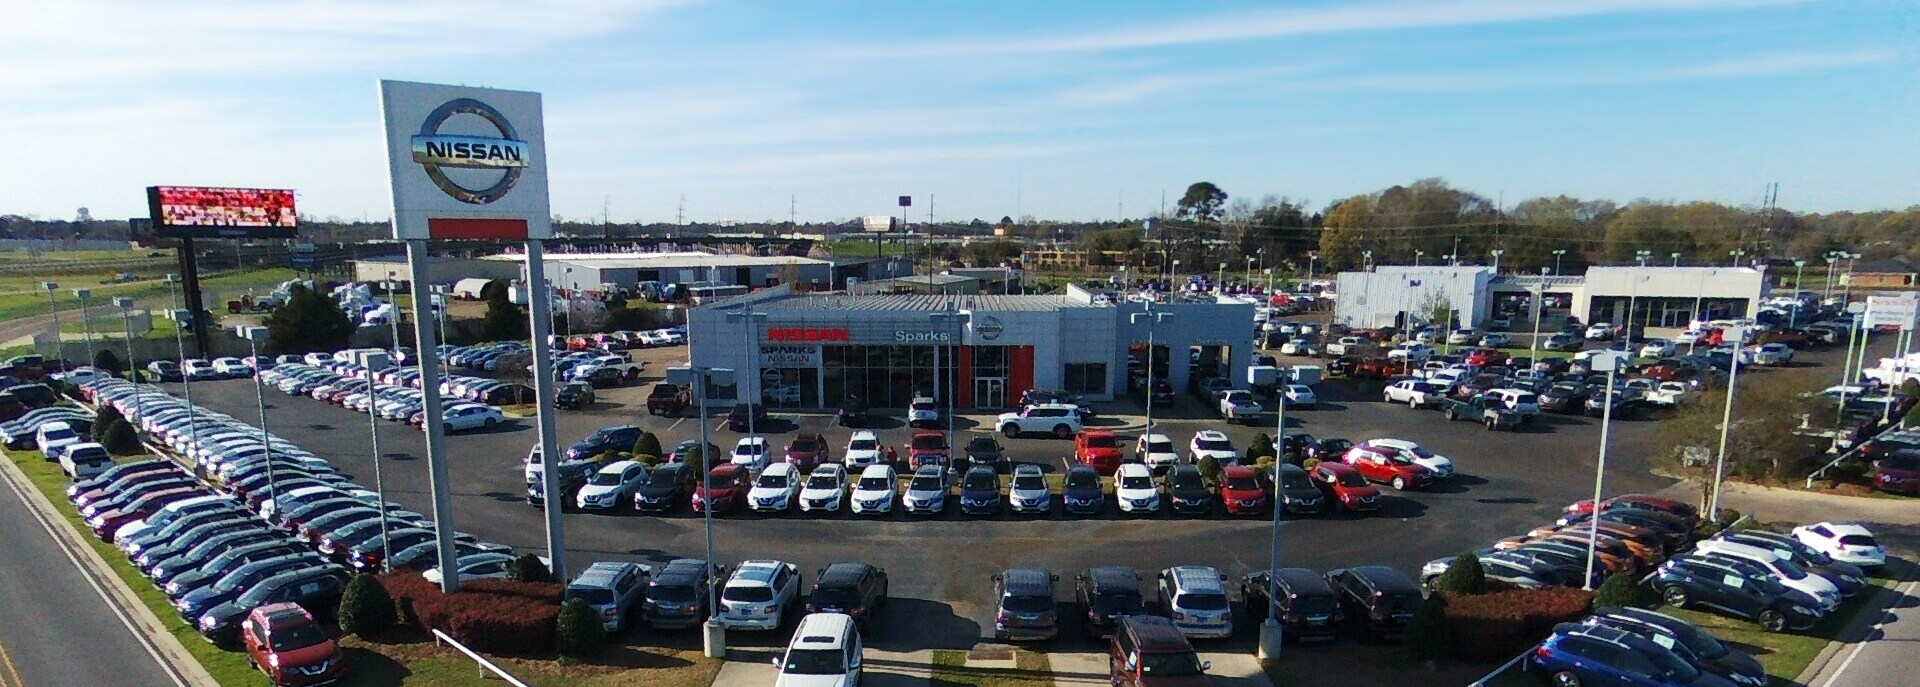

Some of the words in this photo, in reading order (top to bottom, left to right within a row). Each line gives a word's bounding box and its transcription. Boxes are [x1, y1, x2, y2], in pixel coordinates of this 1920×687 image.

[426, 141, 521, 161] NISSAN
[768, 326, 849, 341] NISSAN
[895, 330, 948, 343] Sparks
[760, 346, 816, 354] SPARKS
